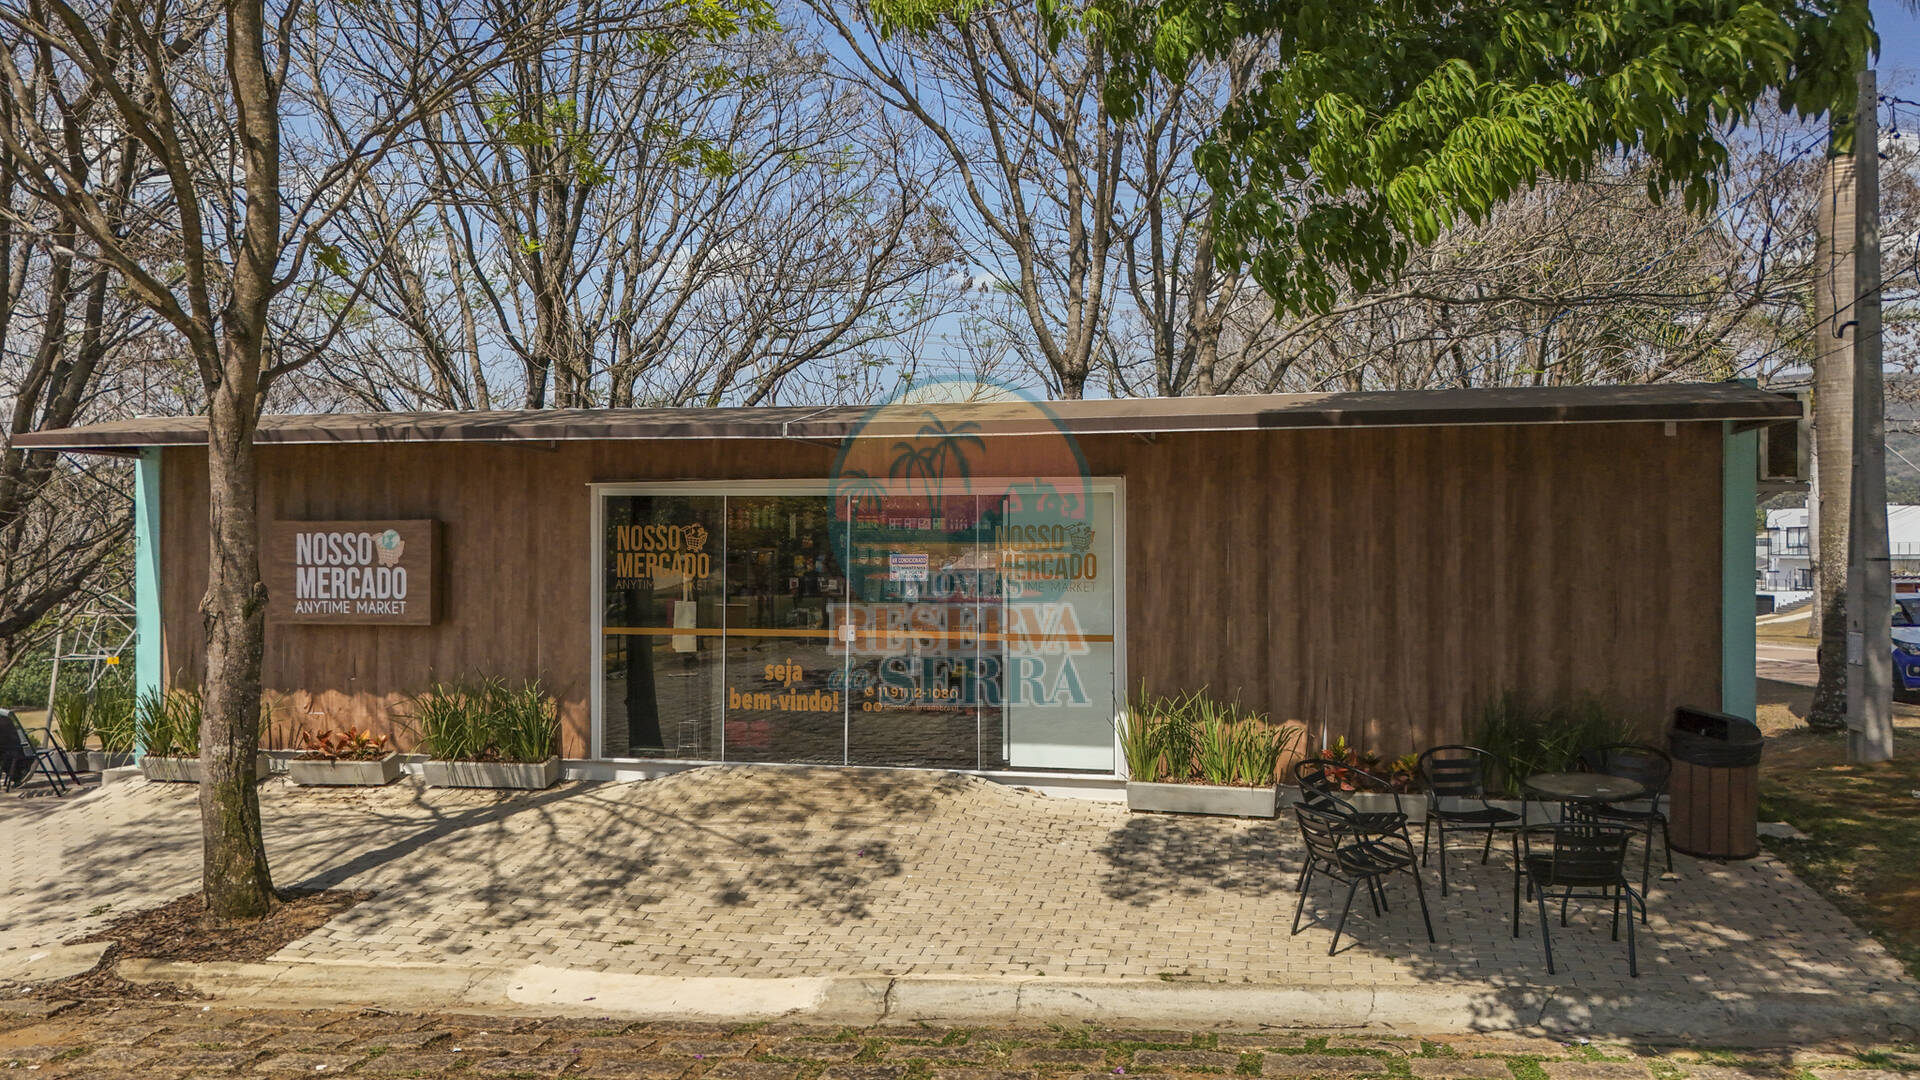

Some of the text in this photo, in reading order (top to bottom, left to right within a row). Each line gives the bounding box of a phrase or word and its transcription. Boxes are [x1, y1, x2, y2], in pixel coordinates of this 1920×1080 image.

[296, 532, 373, 565] NOSSO
[616, 525, 681, 551] NOSSO
[995, 524, 1065, 552] NOSSO
[616, 552, 710, 579] MERCADO
[995, 552, 1098, 580] MERCADO
[296, 567, 407, 600] MERCADO
[1051, 581, 1096, 593] MARKET
[295, 601, 407, 614] ANYTIME MARKET
[764, 657, 803, 688] seja
[729, 687, 839, 712] bem-vindo!
